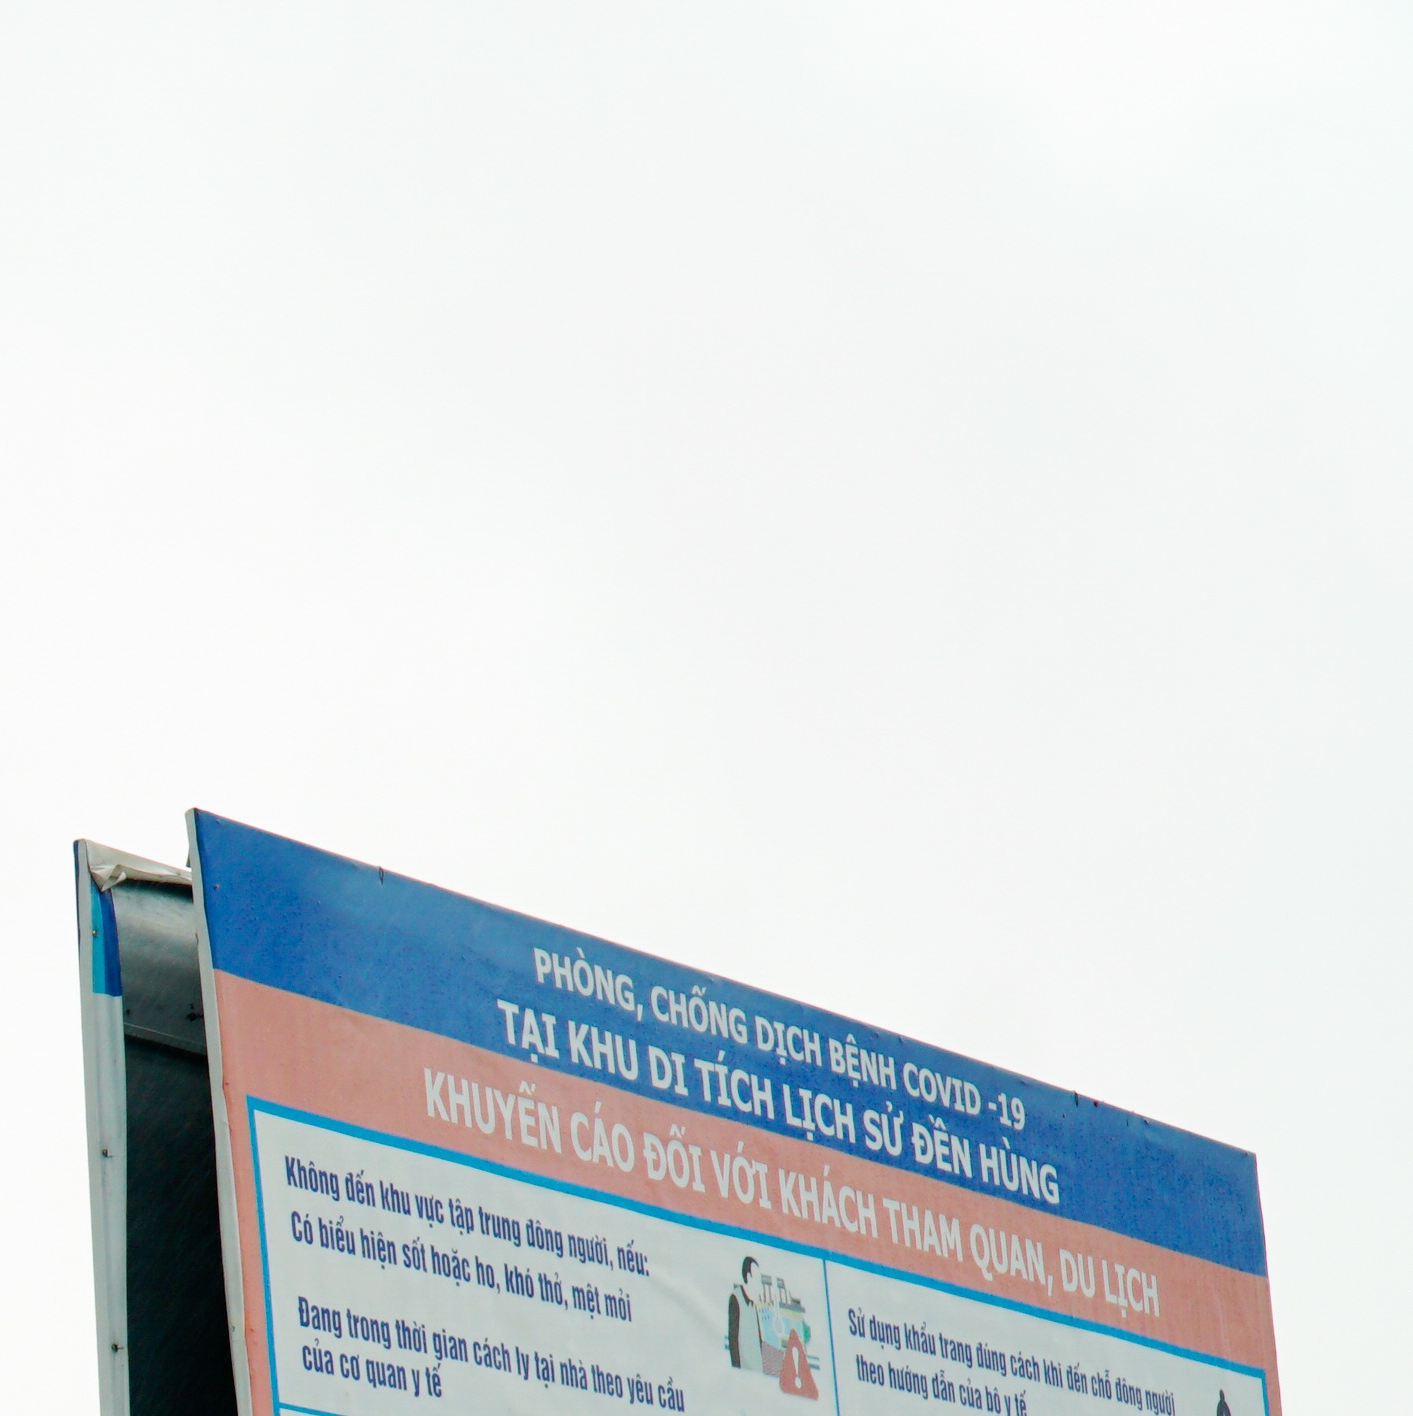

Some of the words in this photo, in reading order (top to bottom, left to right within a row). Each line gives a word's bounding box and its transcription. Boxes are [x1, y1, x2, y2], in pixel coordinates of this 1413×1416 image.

[531, 945, 644, 1022] PHÒNG,
[649, 983, 748, 1046] CHỐNG
[753, 1014, 822, 1067] DỊCH
[827, 1032, 897, 1091] BỆNH
[901, 1061, 981, 1116] COVID
[495, 998, 560, 1063] TẠI
[566, 1019, 639, 1082] KHU
[646, 1044, 689, 1097] DI
[692, 1048, 775, 1120] TÍCH
[781, 1082, 856, 1144] LỊCH
[861, 1099, 904, 1157] SỬ
[909, 1113, 972, 1179] ĐỀN
[977, 1135, 1060, 1205] HÙNG
[284, 1154, 340, 1202] Không
[343, 1168, 376, 1208] đến
[378, 1179, 411, 1216] khu
[413, 1193, 445, 1228] vực
[447, 1197, 475, 1235] tập
[477, 1205, 522, 1248] trung
[524, 1217, 564, 1259] đông
[566, 1233, 613, 1271] người,
[616, 1238, 650, 1277] nếu:
[422, 1066, 562, 1154] KHUYẾN
[569, 1099, 636, 1173] CÁO
[641, 1122, 706, 1193] ĐỐI
[709, 1139, 772, 1210] VỚI
[777, 1163, 879, 1239] KHÁCH
[881, 1196, 964, 1263] THAM
[968, 1222, 1054, 1297] QUAN,
[1058, 1247, 1096, 1299] DU
[1100, 1258, 1160, 1319] LỊCH
[289, 1210, 314, 1245] Có
[316, 1214, 356, 1256] biểu
[358, 1226, 397, 1270] hiện
[401, 1235, 428, 1273] sốt
[429, 1244, 471, 1287] hoặc
[473, 1254, 501, 1294] ho,
[502, 1262, 535, 1299] khó
[536, 1271, 568, 1310] thở,
[570, 1282, 601, 1320] mệt
[603, 1287, 632, 1322] mỏi
[296, 1295, 343, 1339] Đang
[345, 1307, 392, 1350] trong
[394, 1318, 428, 1354] thời
[431, 1327, 469, 1363] gian
[471, 1336, 512, 1373] cách
[514, 1345, 530, 1381] ly
[533, 1350, 555, 1389] tại
[558, 1357, 588, 1391] nhà
[589, 1363, 624, 1399] theo
[625, 1372, 654, 1406] yêu
[656, 1375, 685, 1413] cầu
[300, 1337, 335, 1376] của
[338, 1352, 361, 1382] cơ
[364, 1357, 408, 1391] quan
[410, 1367, 420, 1398] y
[423, 1361, 442, 1398] tế
[854, 1353, 885, 1387] theo
[886, 1361, 929, 1401] hướng
[930, 1368, 956, 1403] dẫn
[957, 1377, 983, 1410] của
